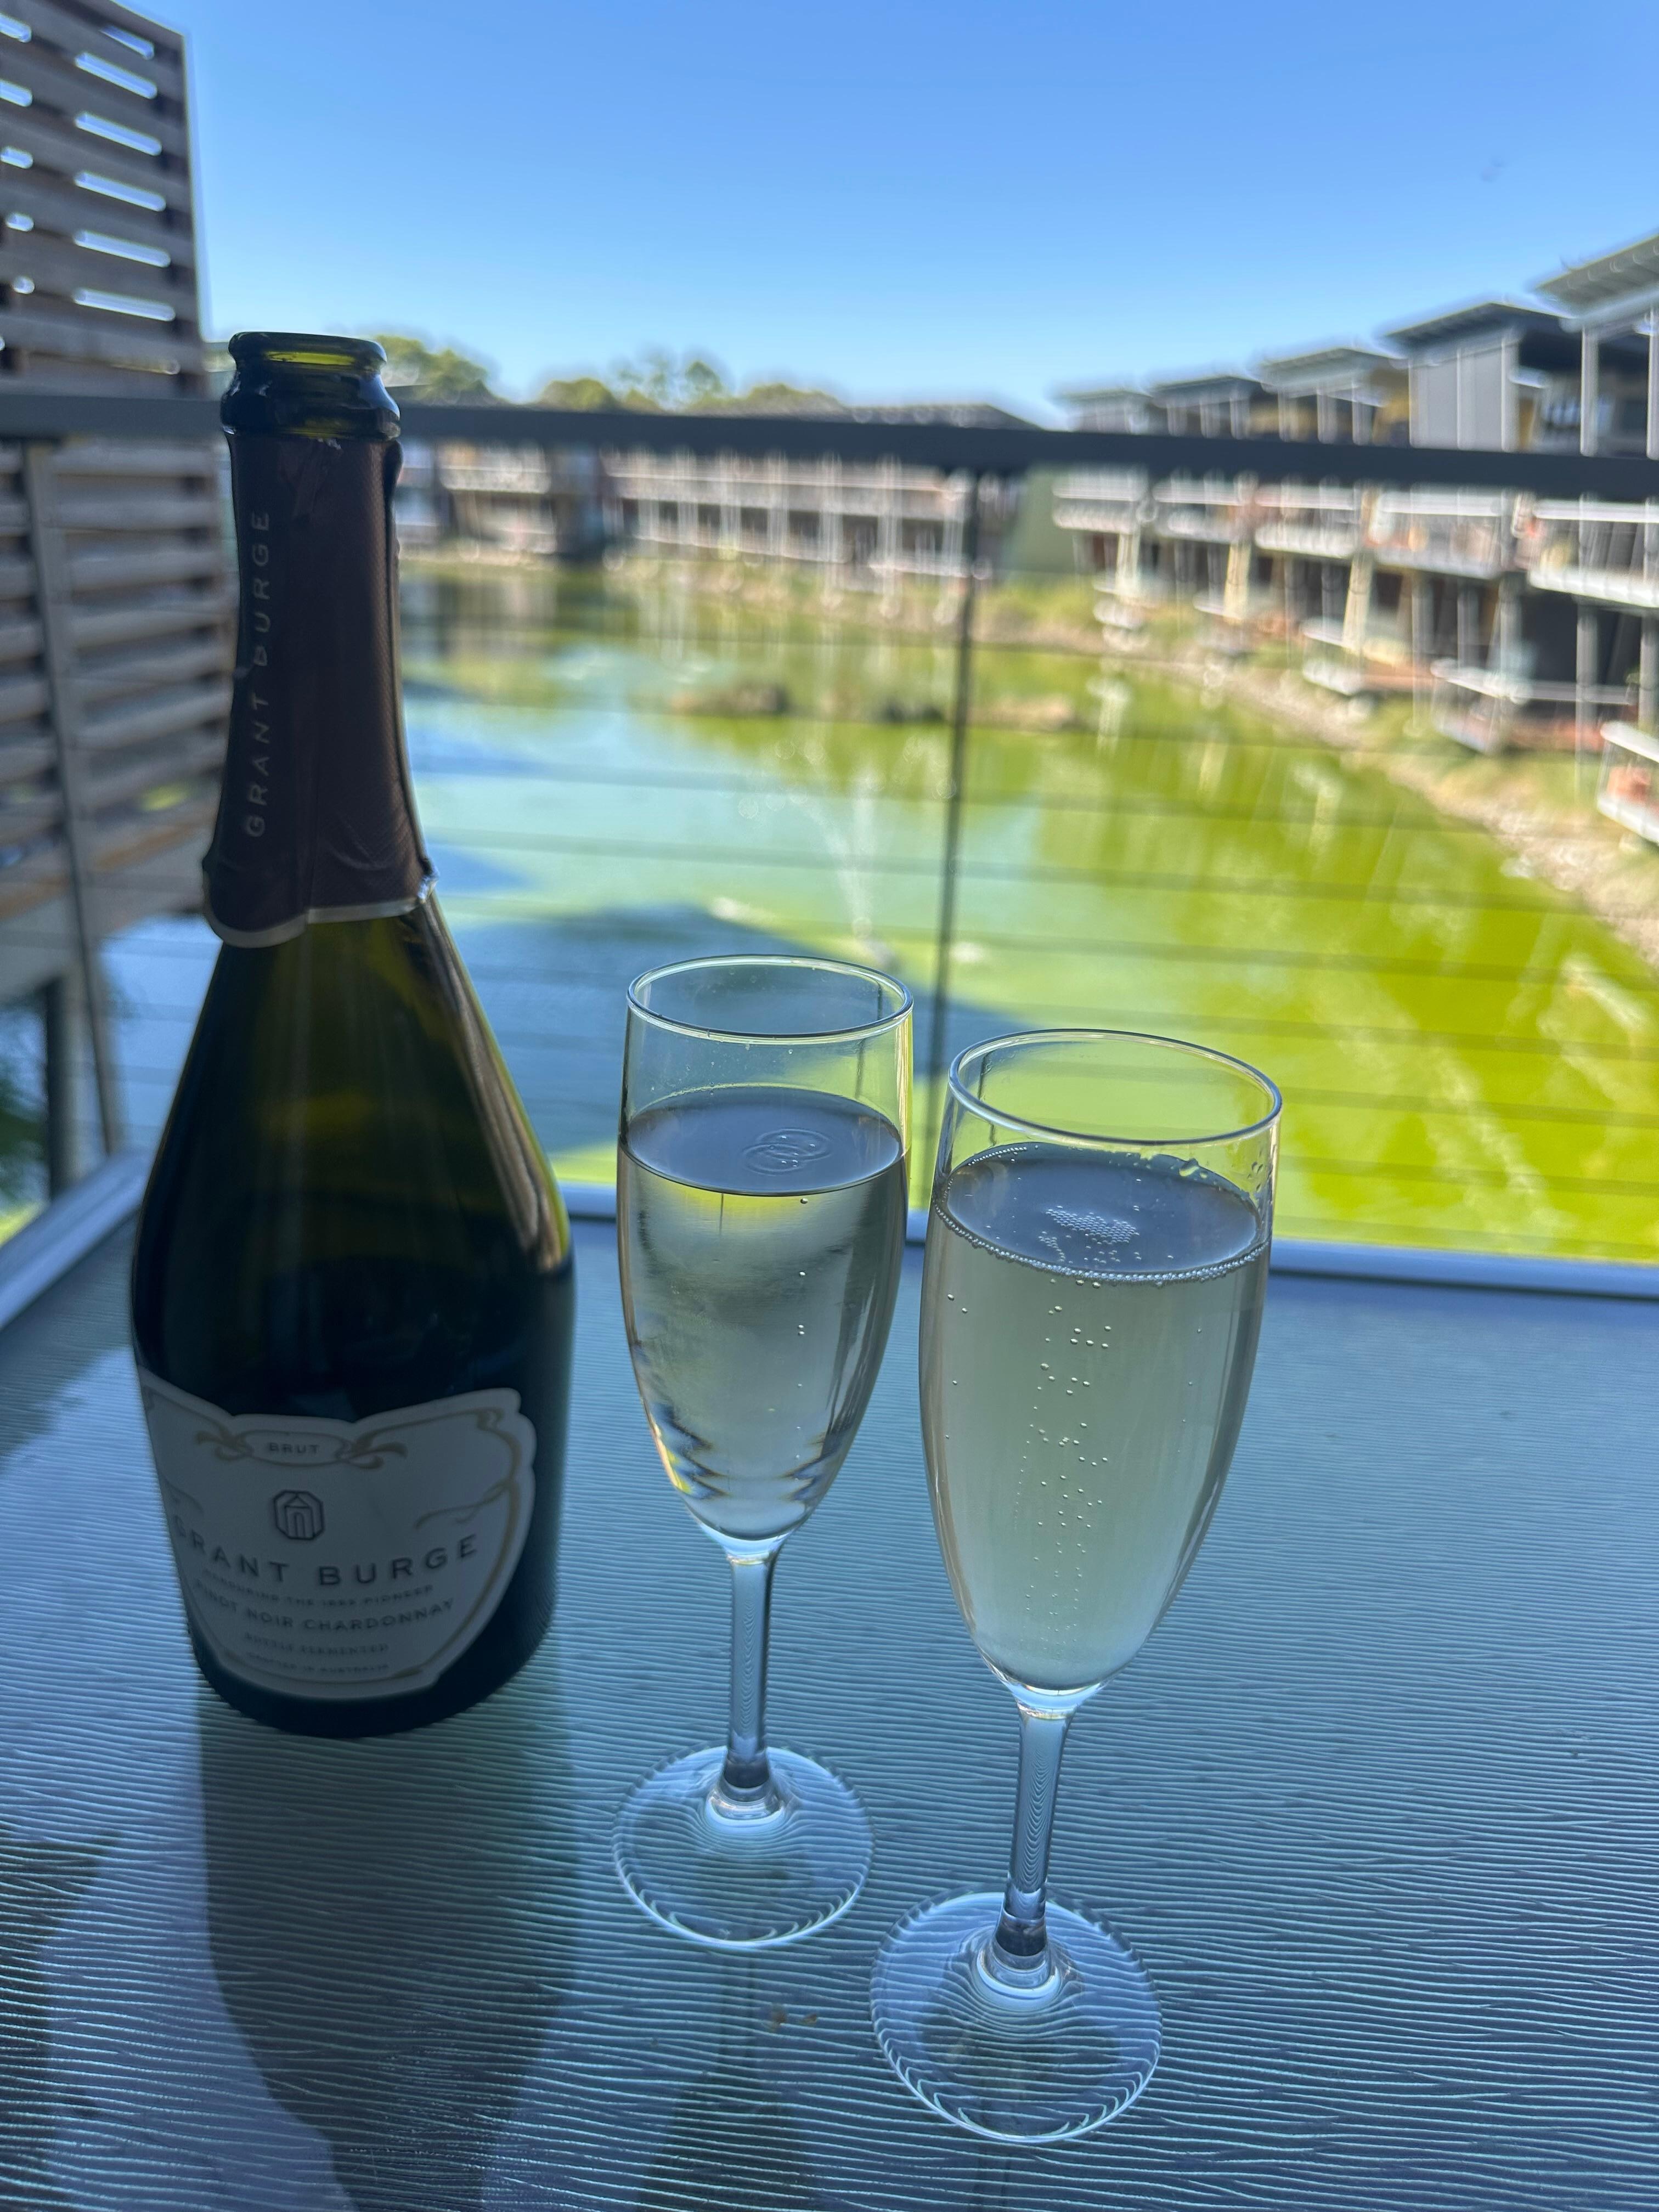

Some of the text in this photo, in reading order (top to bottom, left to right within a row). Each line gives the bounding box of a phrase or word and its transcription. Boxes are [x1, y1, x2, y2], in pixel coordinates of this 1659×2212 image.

[245, 691, 270, 837] GRANT
[268, 1442, 320, 1454] BRUT
[173, 1514, 477, 1586] GRANT BURGE
[193, 1577, 454, 1632] PINOT NOIR CHARDONNAY
